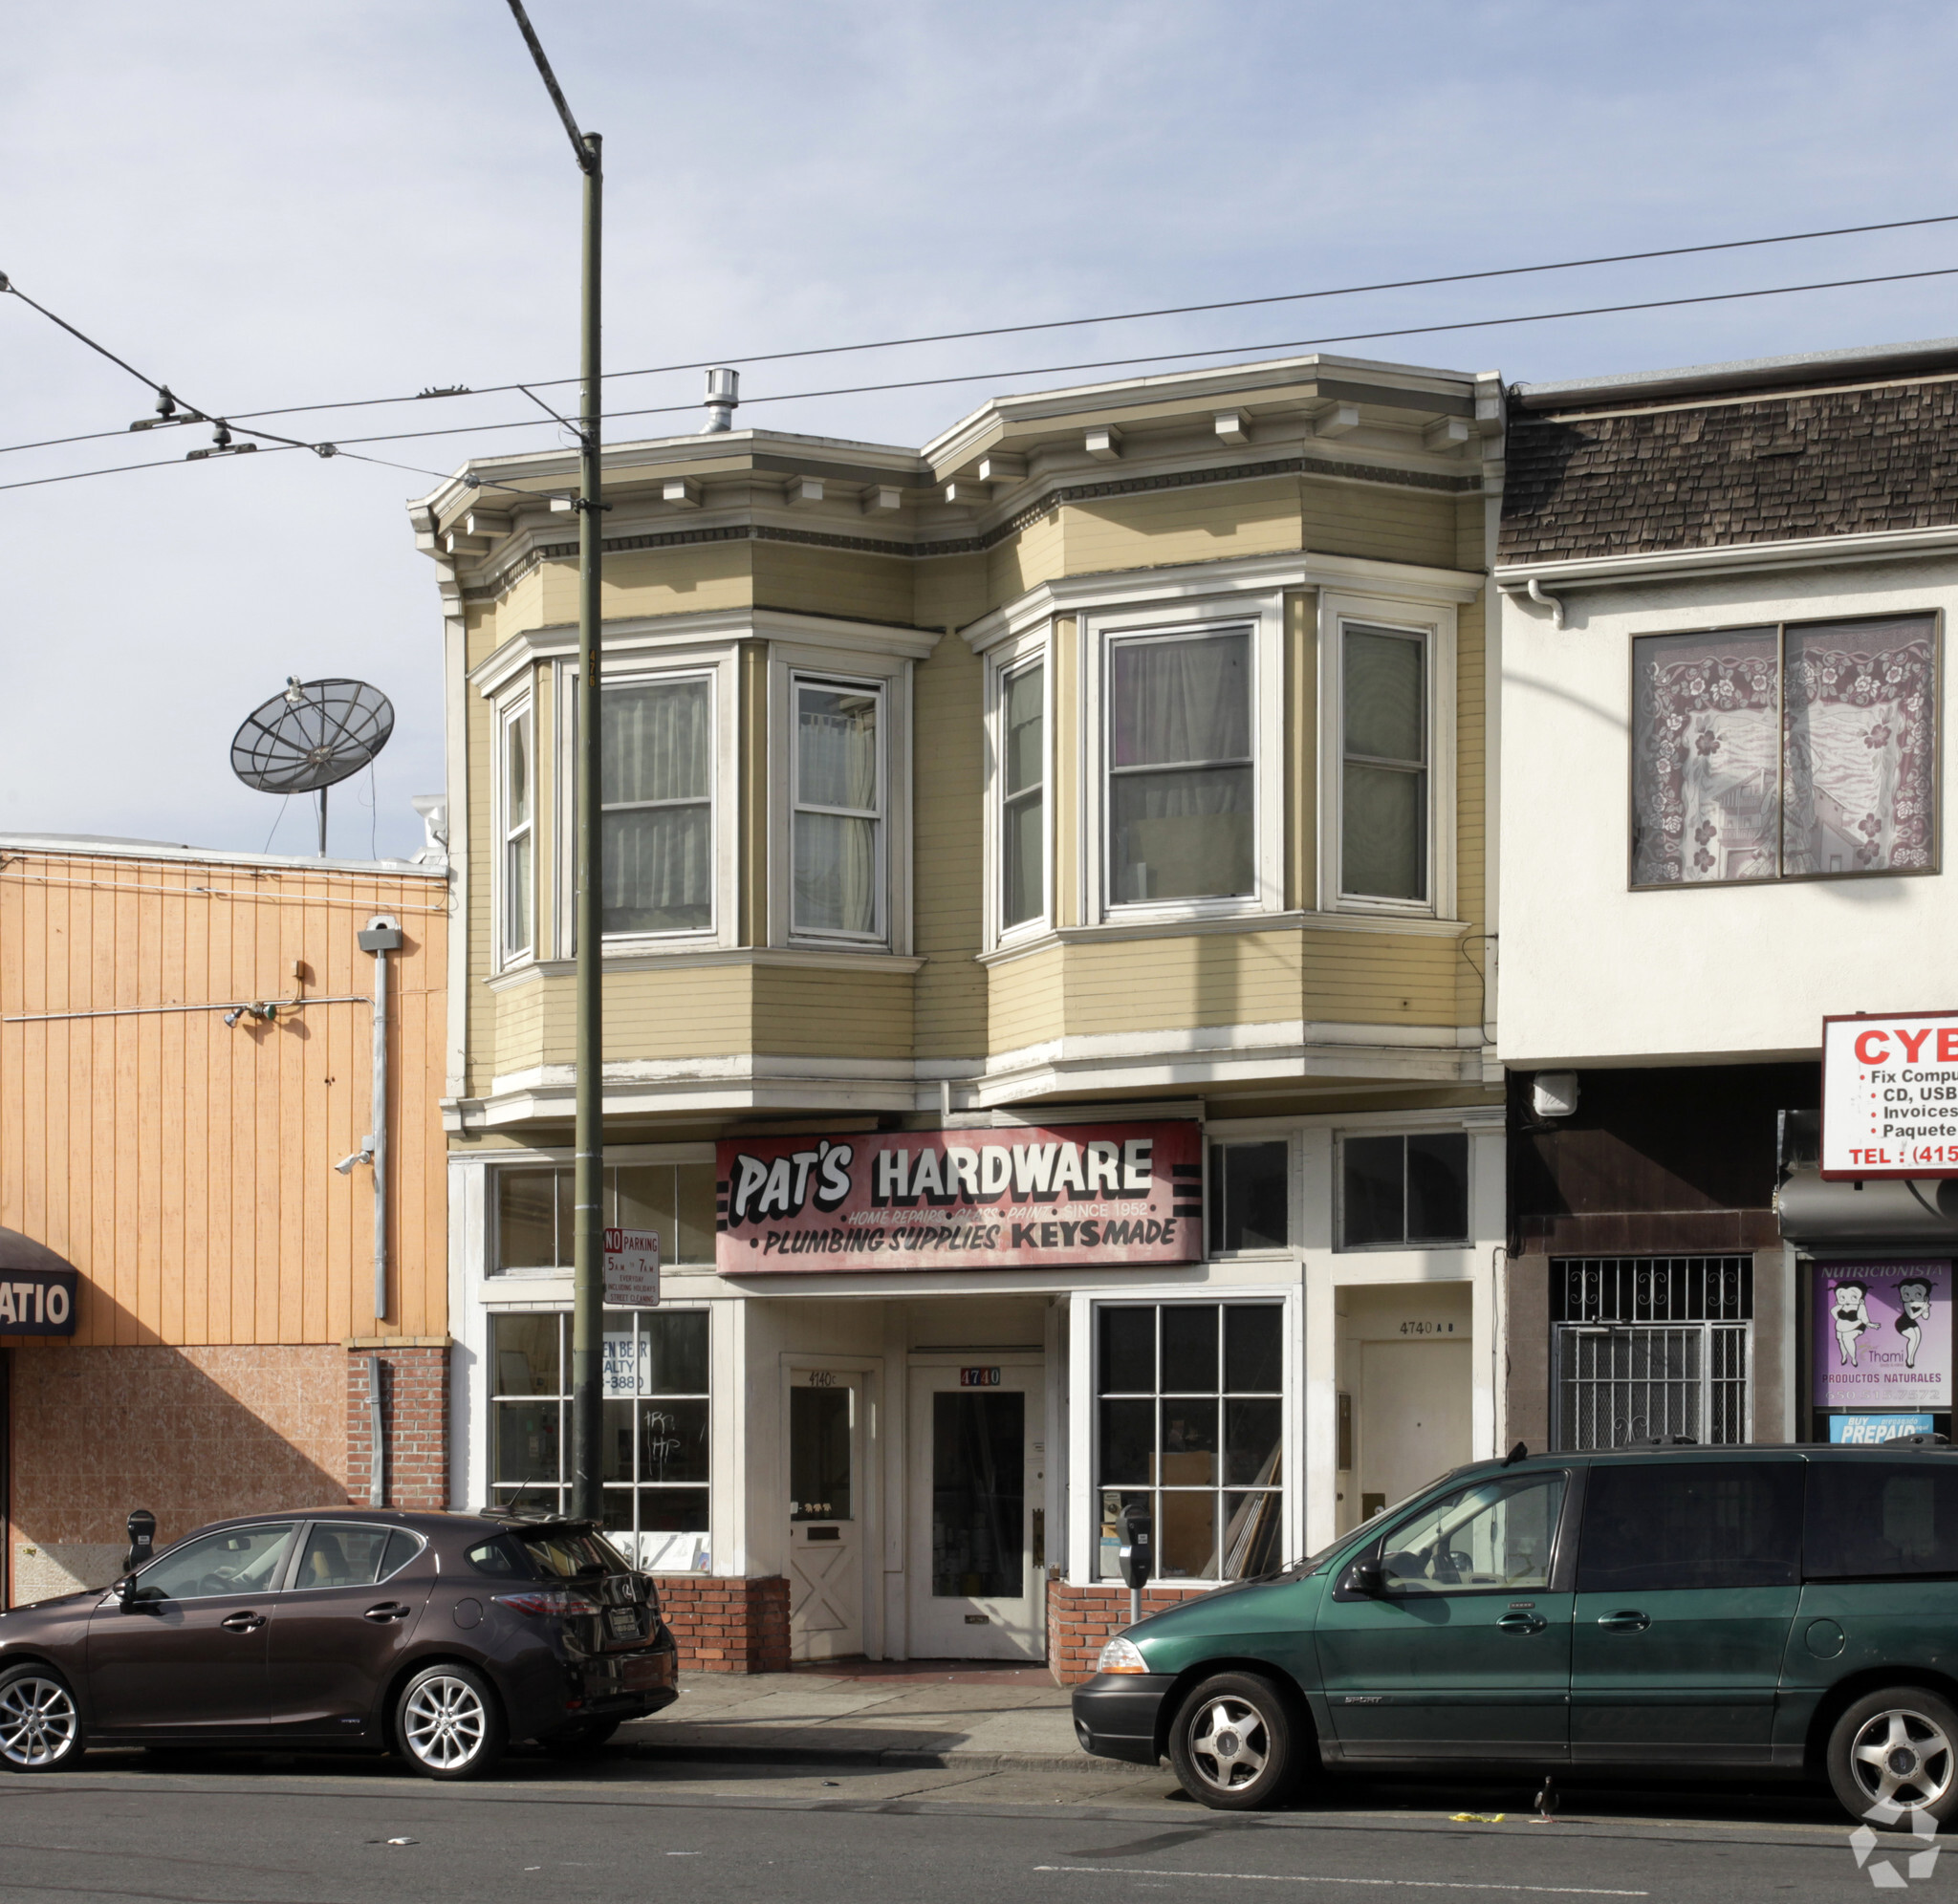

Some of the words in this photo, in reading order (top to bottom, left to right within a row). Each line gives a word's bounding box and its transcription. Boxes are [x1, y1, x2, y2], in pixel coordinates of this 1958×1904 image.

[1871, 1070, 1897, 1084] Fix
[1902, 1069, 1958, 1085] Compu
[1883, 1088, 1914, 1104] CD,
[1920, 1087, 1958, 1101] USB
[1883, 1104, 1958, 1119] Invoices
[1883, 1123, 1957, 1140] Paquete
[733, 1139, 853, 1217] PAT'S
[877, 1137, 1155, 1201] HARDWARE
[847, 1209, 890, 1226] HOME
[890, 1206, 945, 1224] REPAIRS
[1006, 1204, 1053, 1222] PAINT
[1063, 1202, 1109, 1219] SINCE
[1113, 1201, 1149, 1217] 1952
[606, 1230, 620, 1249] NO
[623, 1236, 658, 1252] PARKING
[763, 1225, 885, 1256] PLUMBING
[889, 1223, 1001, 1253] SUPPLIES
[1012, 1220, 1103, 1248] KEYS
[1101, 1217, 1178, 1246] MADE
[620, 1274, 644, 1283] EVERYDAY
[1821, 1265, 1943, 1278] NUTRICIONISTA
[0, 1282, 70, 1325] ATIO
[1400, 1321, 1433, 1334] 4740
[1868, 1349, 1904, 1363] Thami
[603, 1360, 635, 1374] ALTY
[962, 1368, 1000, 1385] 4740
[1822, 1373, 1881, 1384] PRODUCTOS
[1883, 1373, 1942, 1384] NATURALES
[1848, 1417, 1869, 1426] BUY
